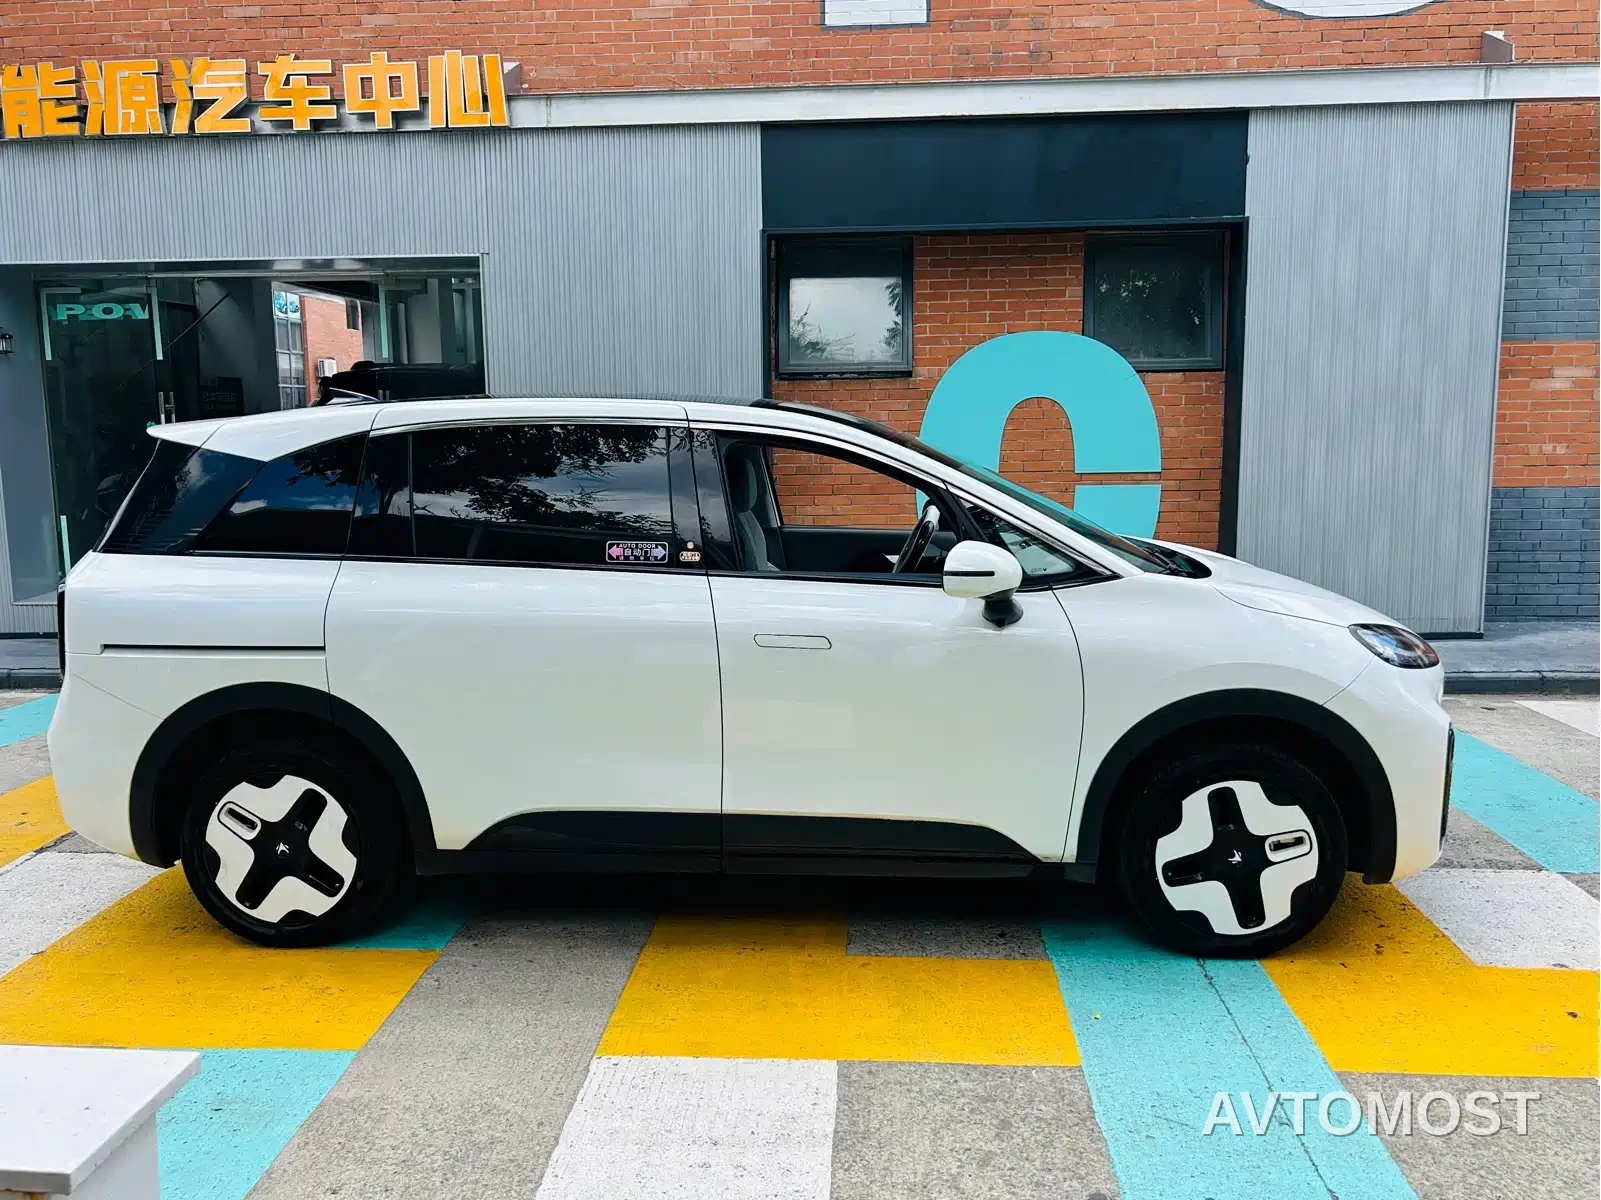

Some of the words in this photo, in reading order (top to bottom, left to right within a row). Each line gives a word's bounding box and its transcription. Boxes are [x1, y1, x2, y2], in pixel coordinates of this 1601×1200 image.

[1, 49, 509, 138] 能源汽车中心
[624, 548, 651, 557] 自动门
